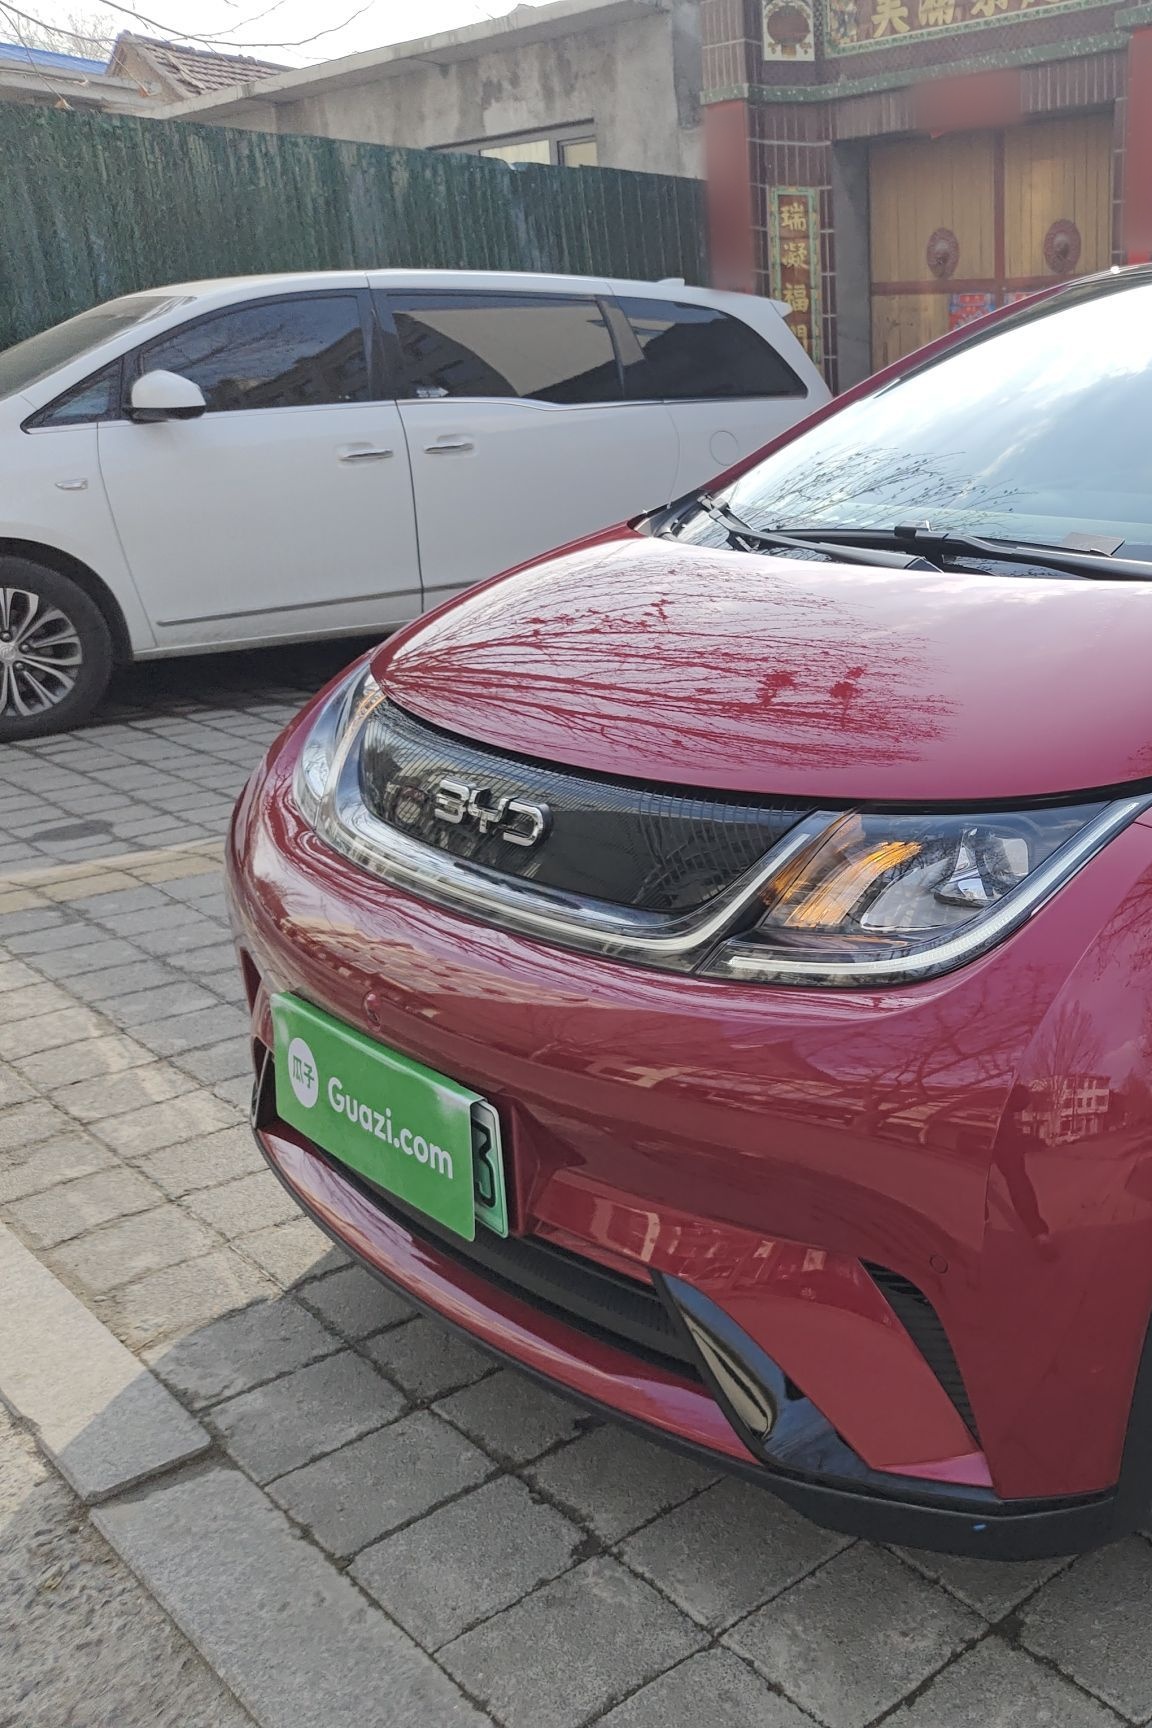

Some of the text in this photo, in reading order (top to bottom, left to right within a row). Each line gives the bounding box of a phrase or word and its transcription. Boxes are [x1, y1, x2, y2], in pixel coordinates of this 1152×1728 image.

[434, 777, 550, 847] BYD
[292, 1054, 315, 1089] 瓜子
[327, 1076, 454, 1181] Guazi.com
